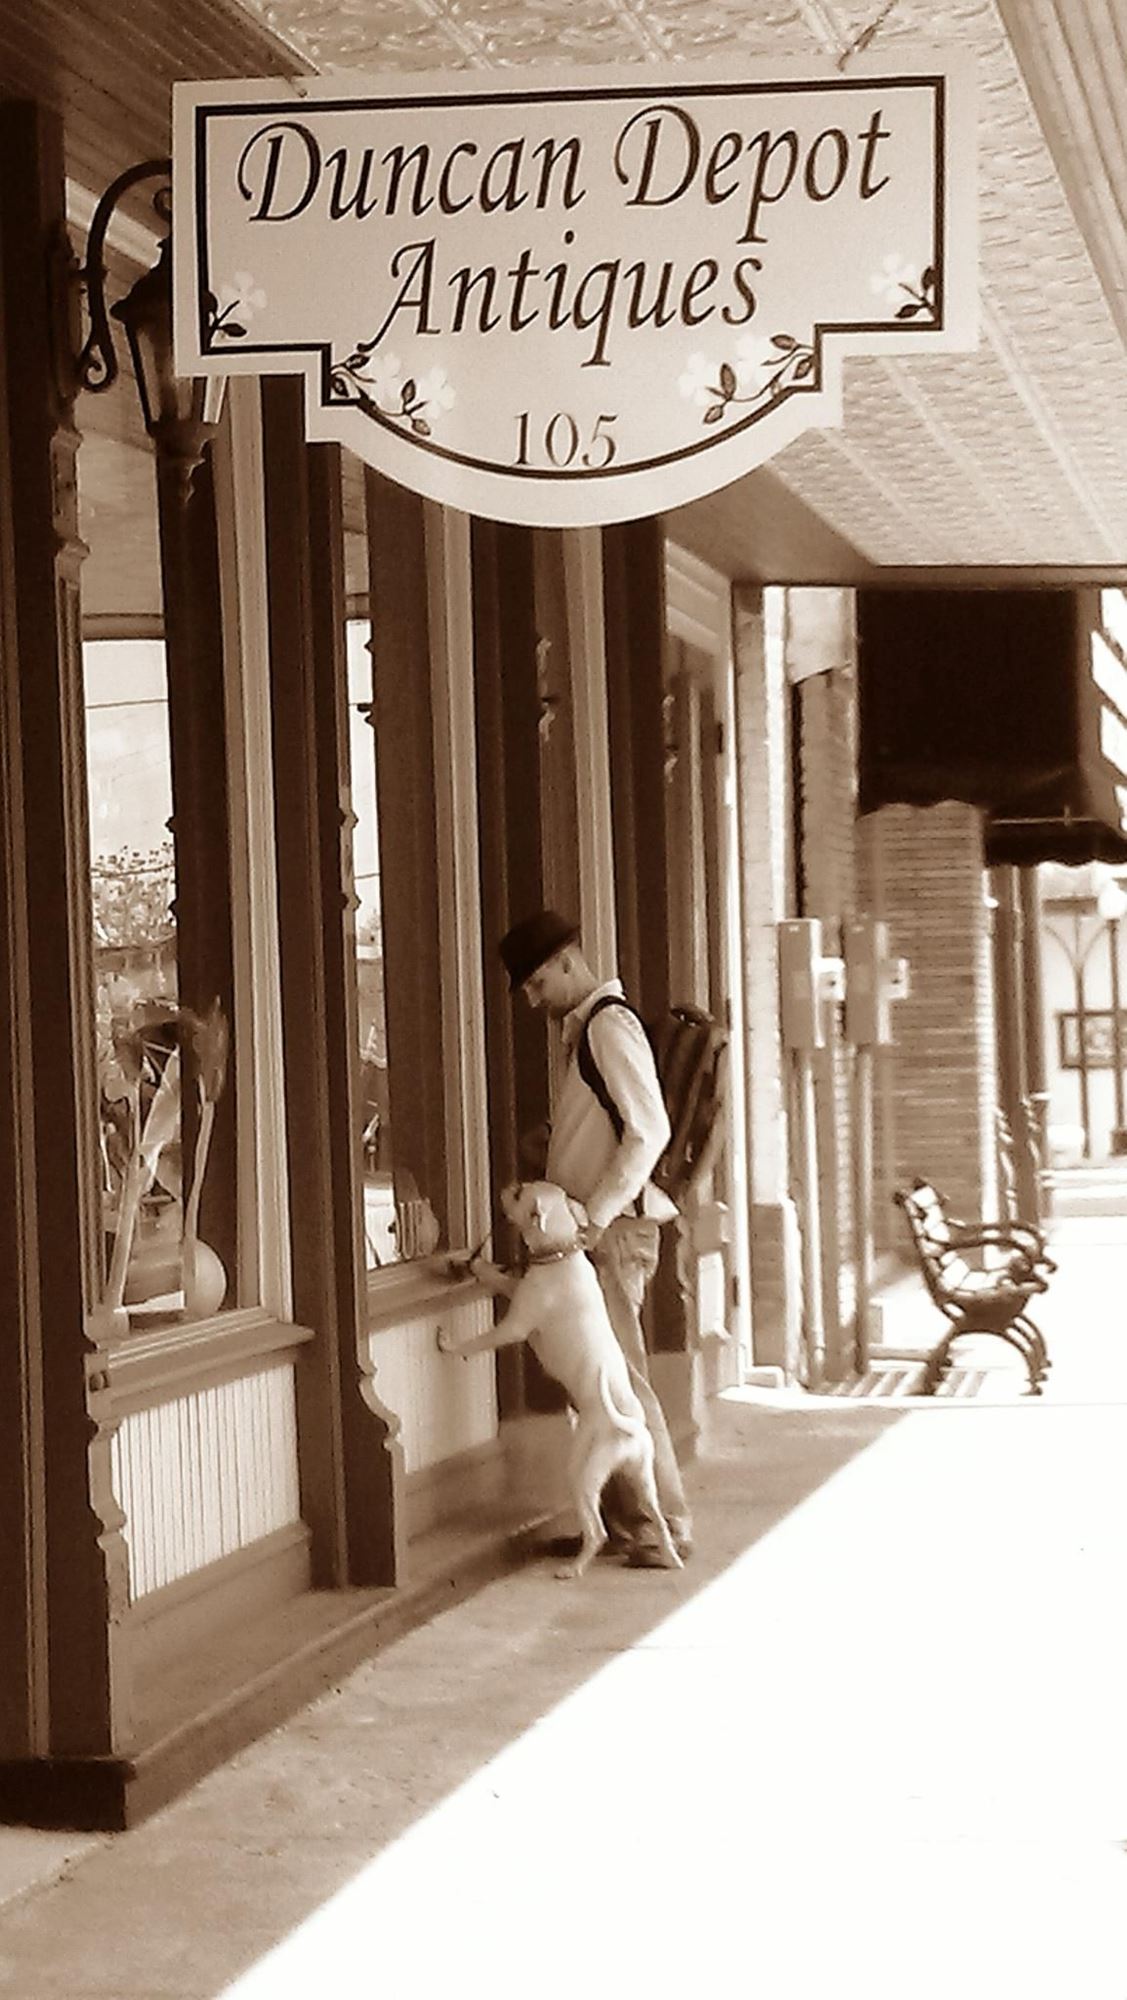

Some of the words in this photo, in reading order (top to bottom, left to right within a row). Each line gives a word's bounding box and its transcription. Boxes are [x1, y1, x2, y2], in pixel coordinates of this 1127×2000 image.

[237, 121, 587, 223] Duncan
[614, 104, 892, 245] Depot
[358, 230, 764, 368] Antiques
[513, 411, 619, 469] 105
